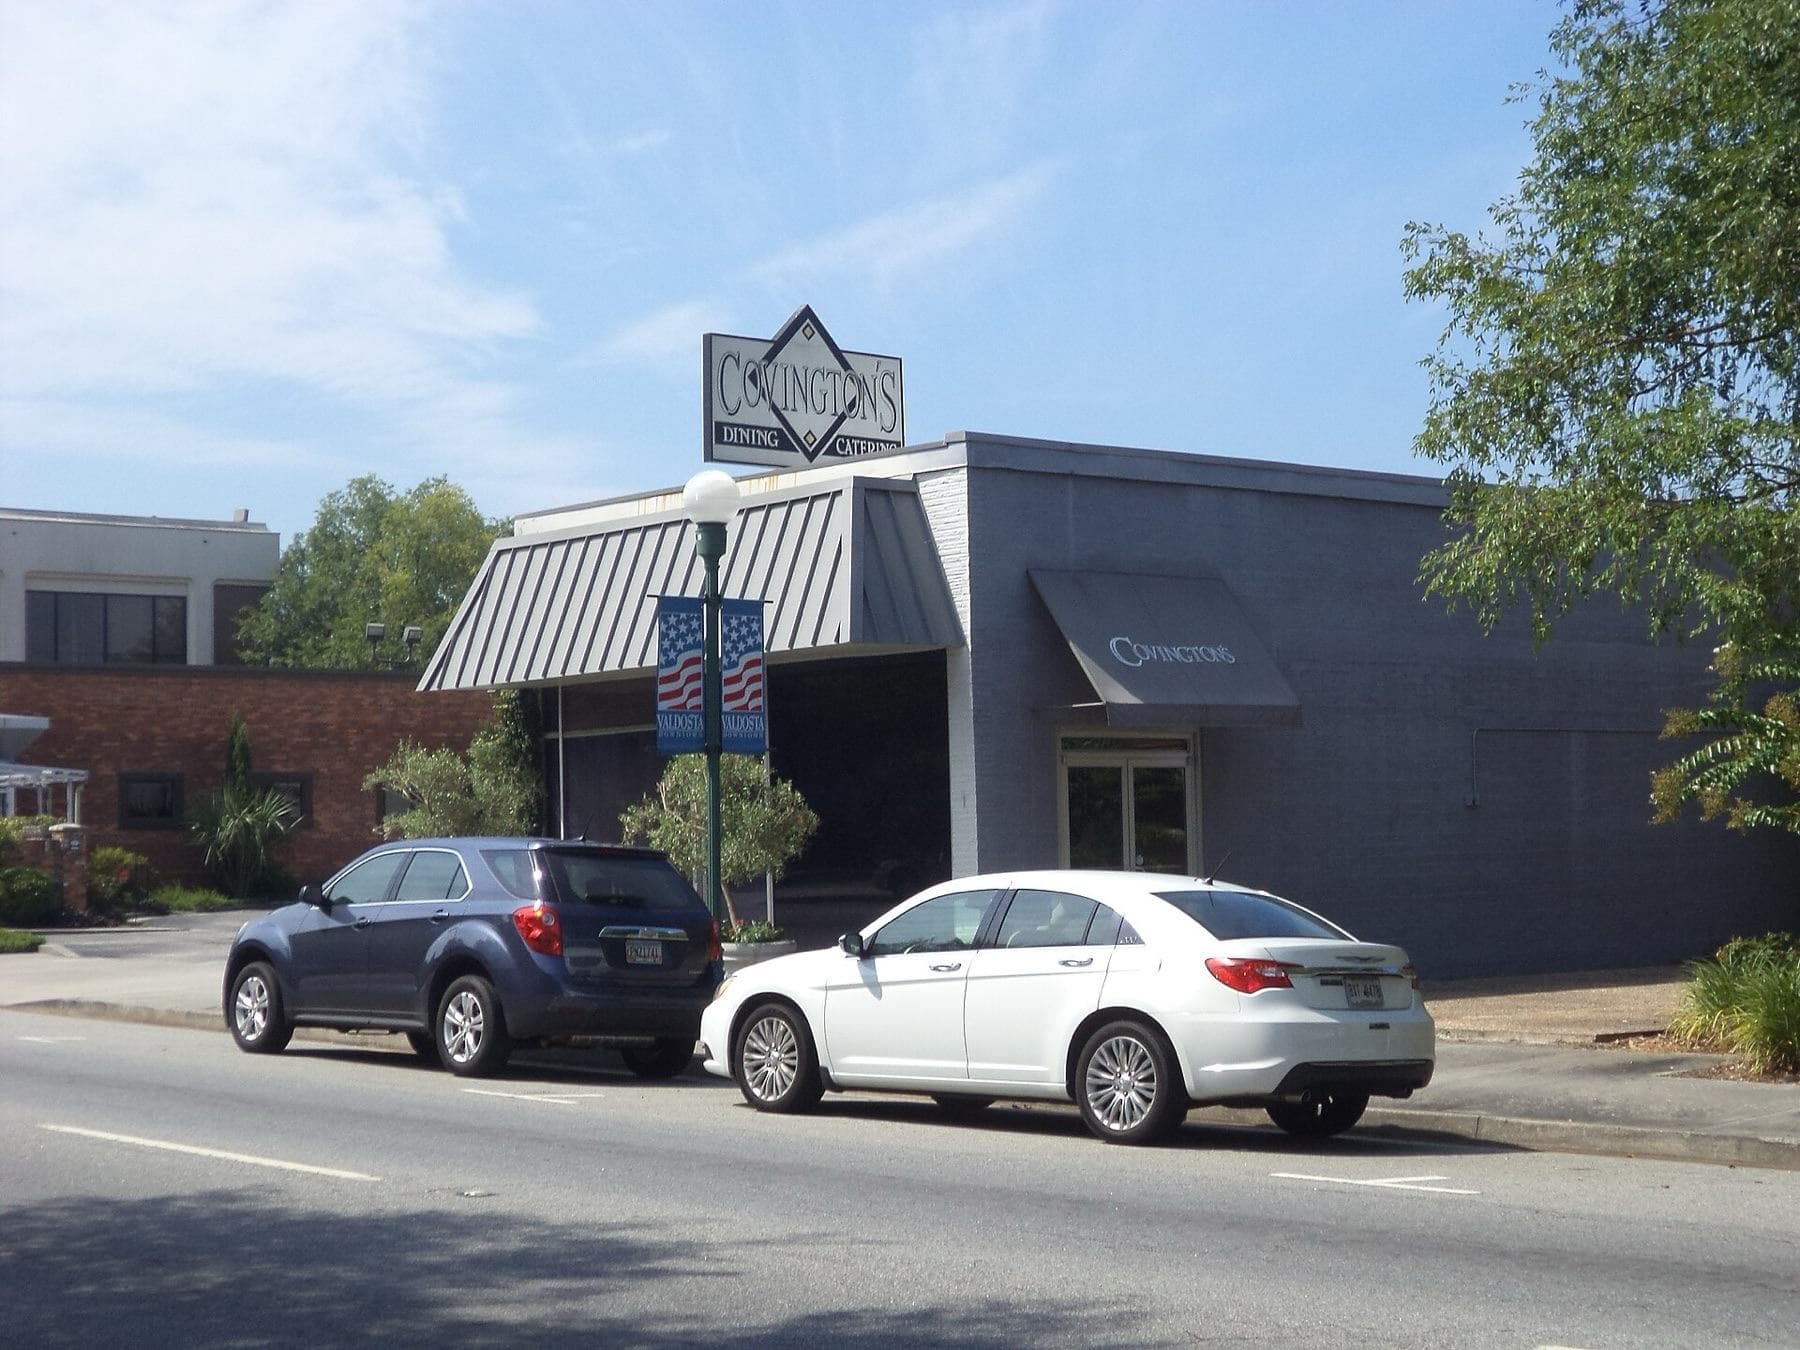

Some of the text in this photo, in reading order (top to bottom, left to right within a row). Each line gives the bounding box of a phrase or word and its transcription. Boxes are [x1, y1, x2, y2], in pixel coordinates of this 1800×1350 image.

[717, 351, 897, 433] COVINGTON'S
[723, 426, 780, 447] DINING
[656, 713, 704, 729] VALDOSTA
[721, 714, 764, 730] VALDOSTA
